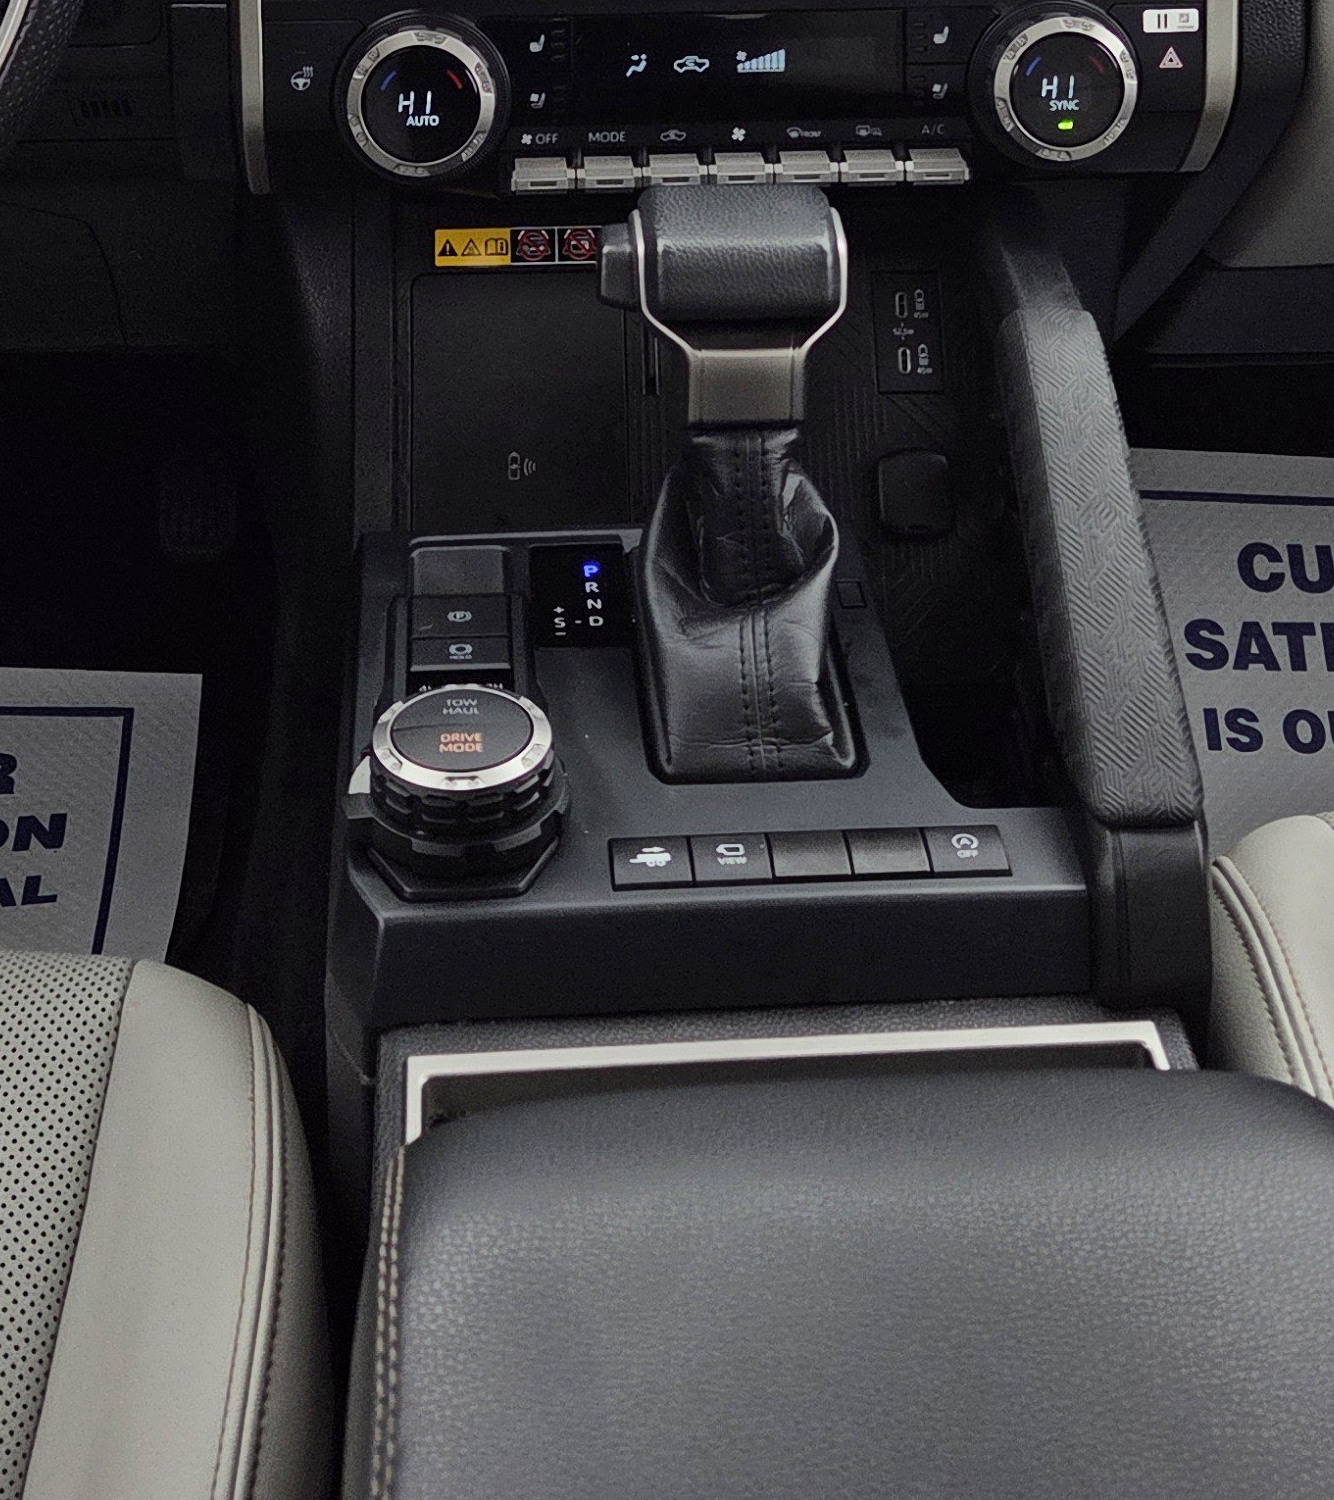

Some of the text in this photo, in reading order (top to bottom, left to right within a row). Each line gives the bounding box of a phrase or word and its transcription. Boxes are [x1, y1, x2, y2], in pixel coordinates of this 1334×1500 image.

[1049, 99, 1080, 111] SYNC
[405, 115, 440, 127] AUTO
[921, 123, 945, 135] A/C
[535, 132, 559, 144] OFF
[588, 131, 627, 143] MODE
[583, 564, 600, 578] P
[585, 581, 600, 593] R
[586, 598, 602, 609] N
[554, 617, 566, 628] S
[589, 615, 604, 627] D
[446, 699, 478, 707] TOW
[442, 707, 479, 715] HAUL
[1202, 706, 1265, 753] IS
[440, 733, 483, 743] DRIVE
[439, 743, 483, 753] MODE
